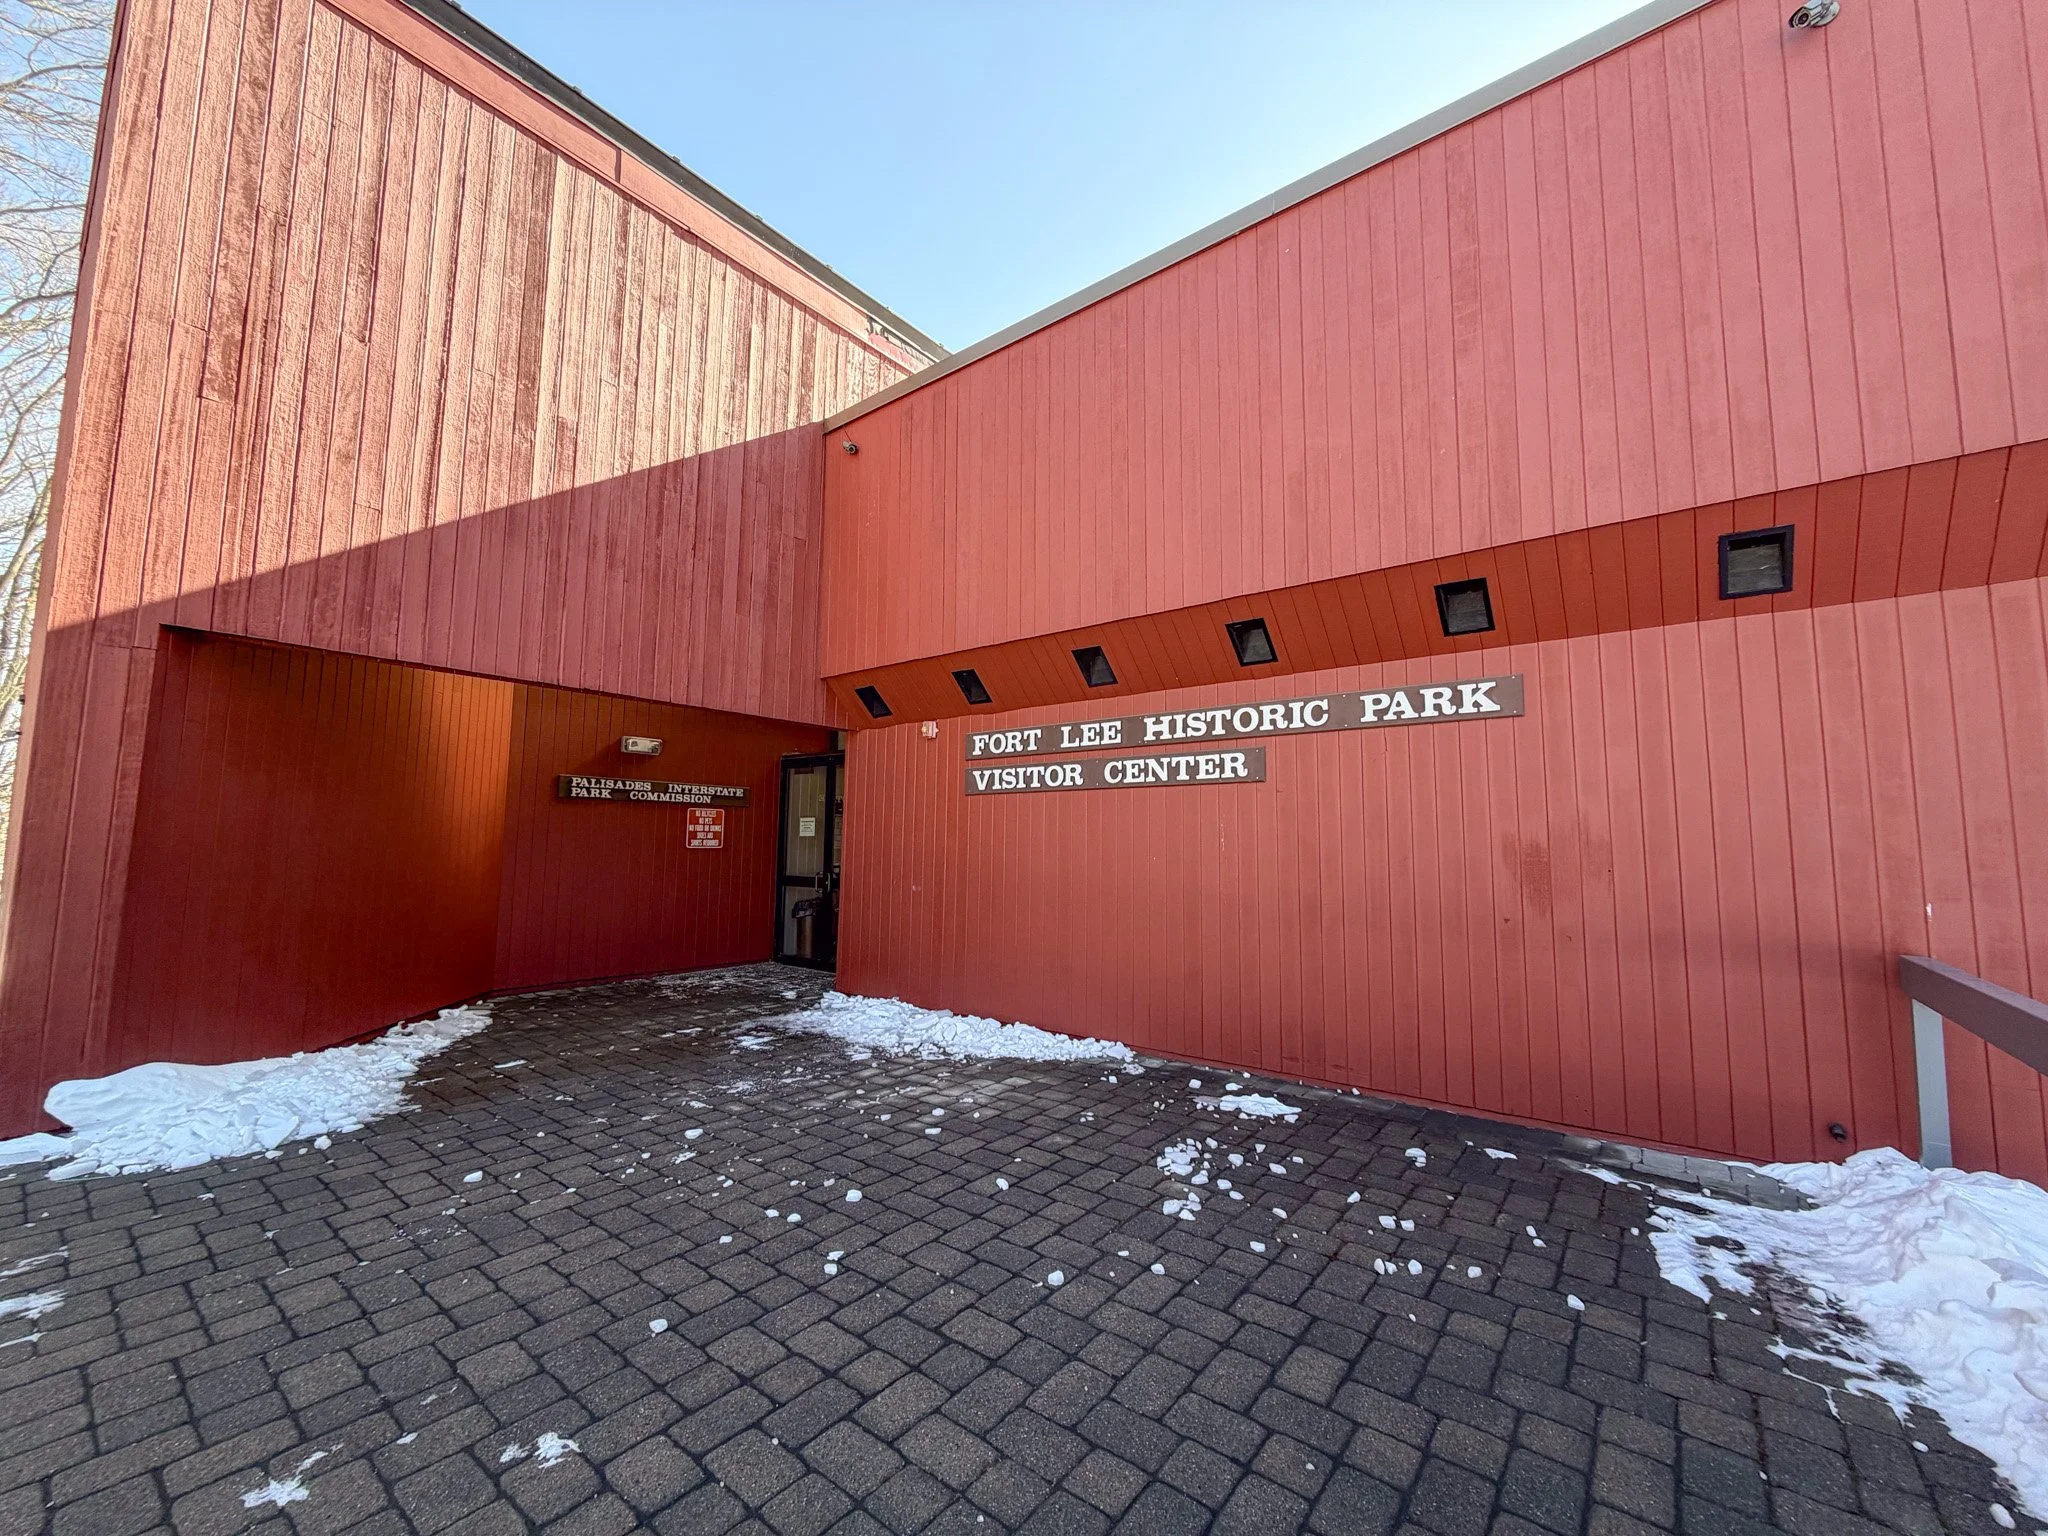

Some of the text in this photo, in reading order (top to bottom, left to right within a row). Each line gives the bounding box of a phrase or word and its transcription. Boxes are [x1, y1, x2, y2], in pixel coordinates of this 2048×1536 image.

[972, 681, 1501, 756] FORT LEE HISTORIC PARK
[972, 751, 1249, 791] VISITOR CENTER
[570, 787, 712, 804] PARK COMMISSION
[571, 777, 744, 797] PALISADES INTERSTATE
